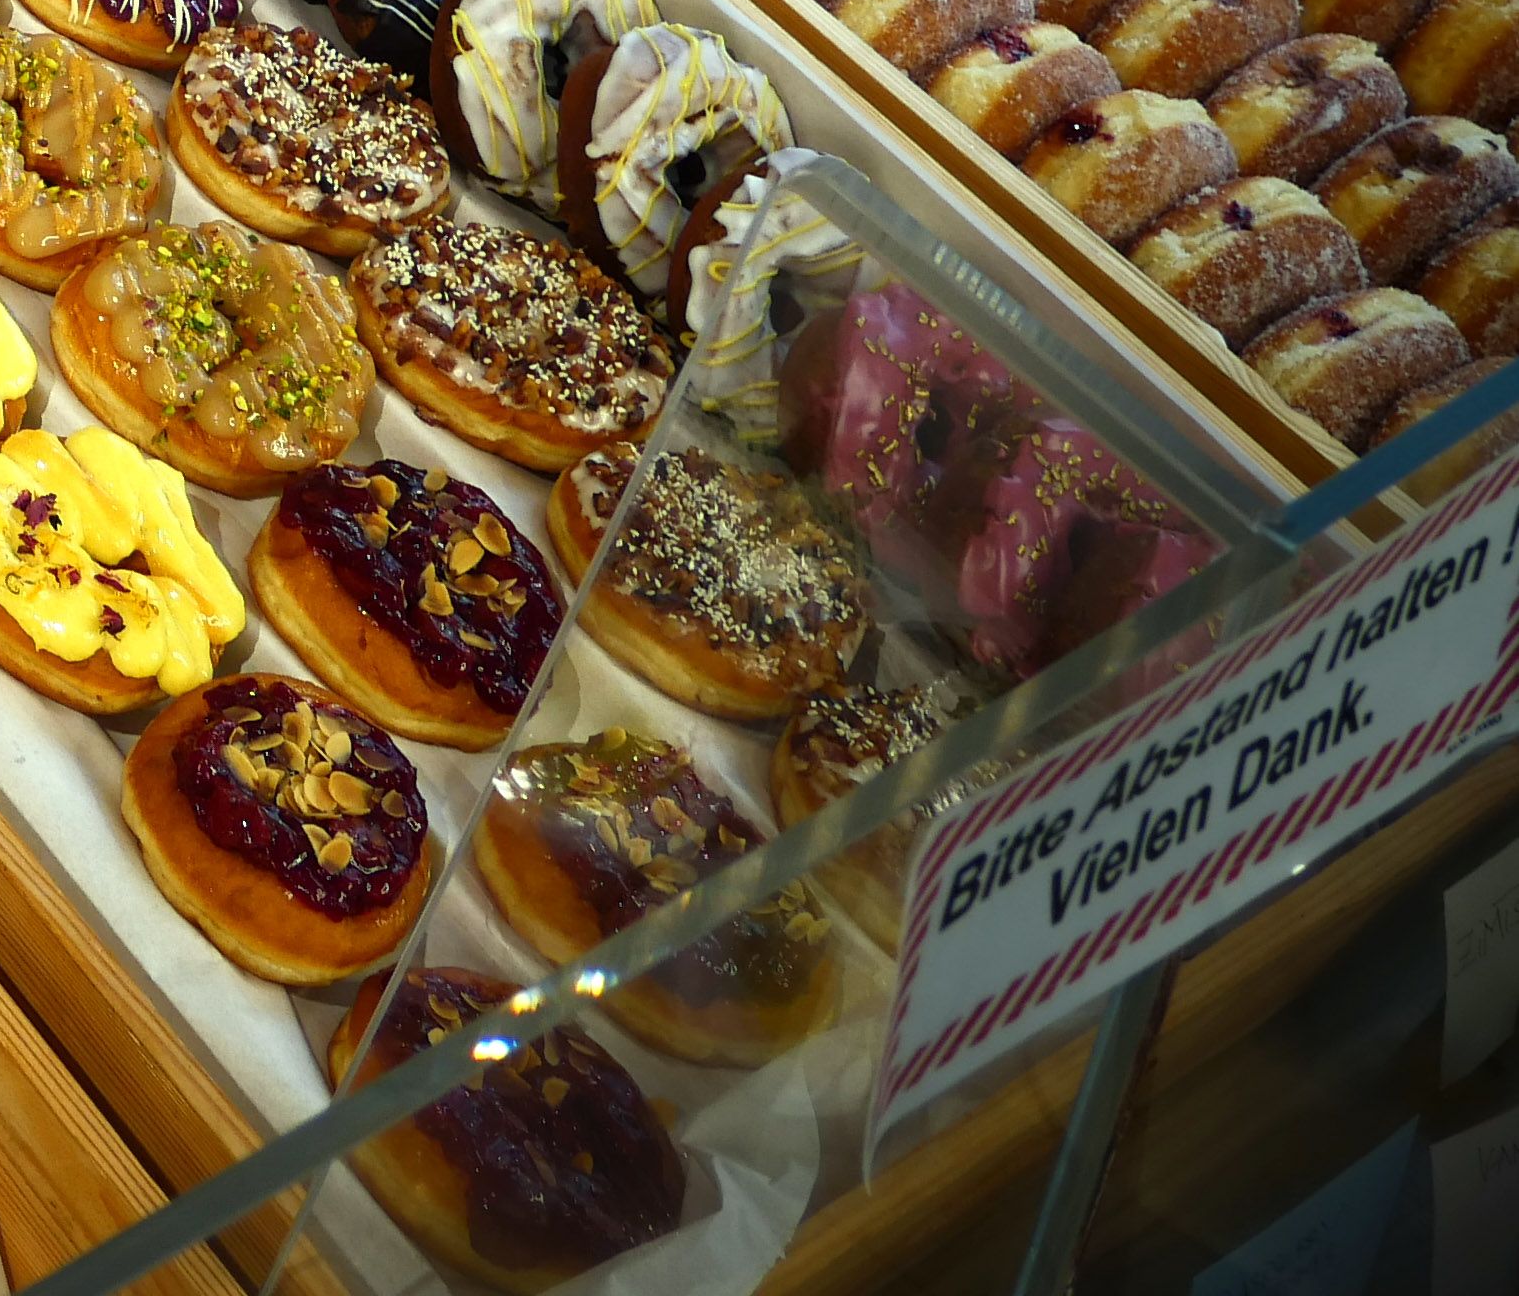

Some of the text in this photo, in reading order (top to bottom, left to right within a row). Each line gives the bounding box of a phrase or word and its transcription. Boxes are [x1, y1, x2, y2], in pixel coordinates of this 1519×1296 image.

[938, 807, 1074, 932] Bitte
[1079, 629, 1326, 833] Abstand
[1325, 536, 1490, 673] halten
[1051, 677, 1374, 927] Vielen Dank.
